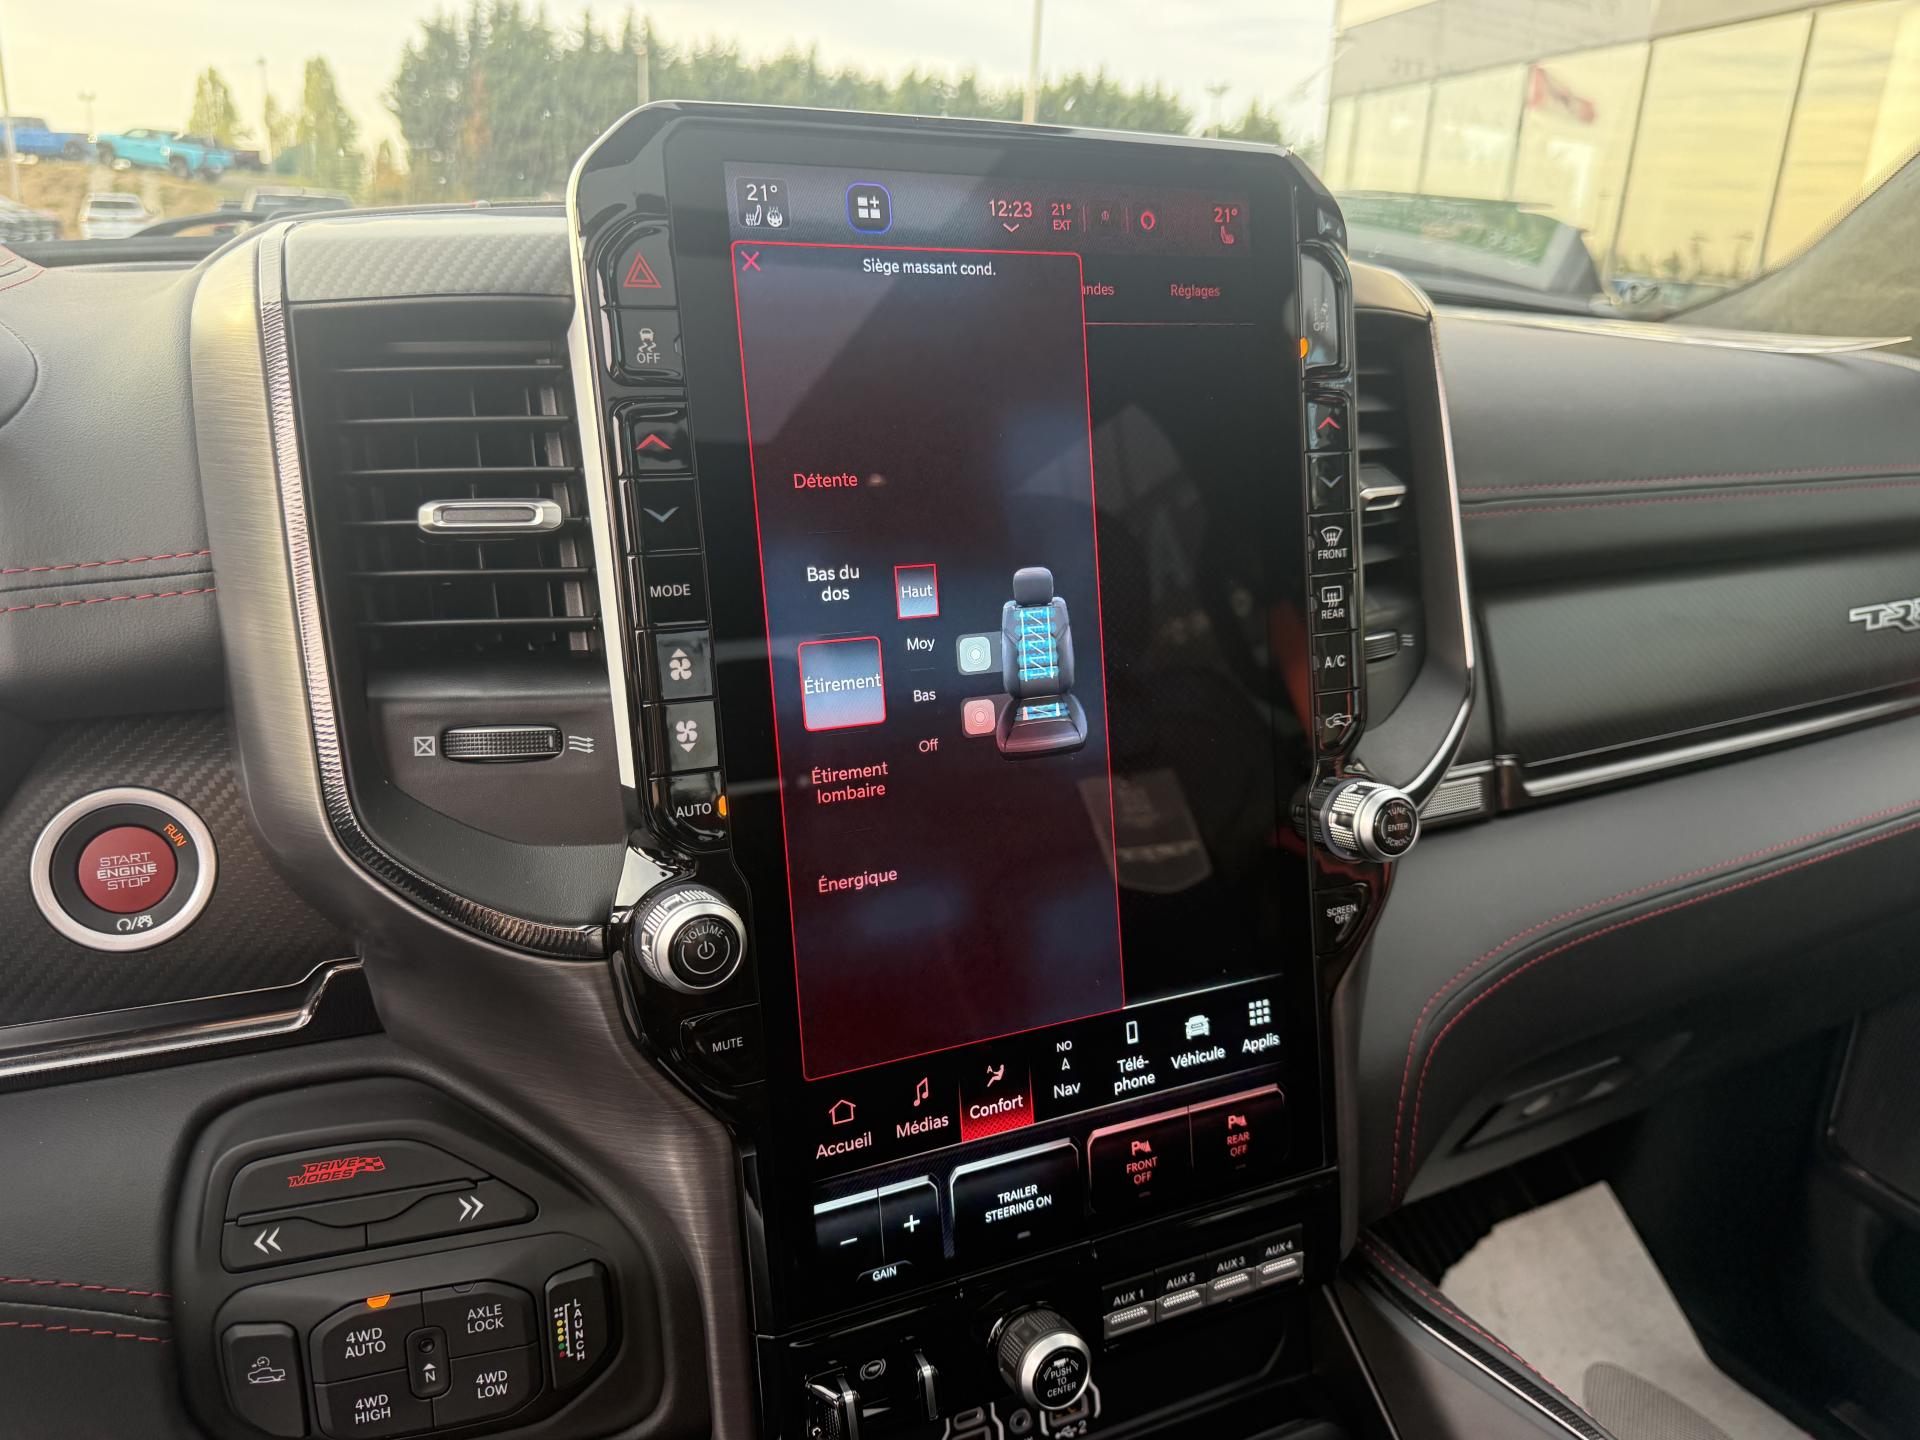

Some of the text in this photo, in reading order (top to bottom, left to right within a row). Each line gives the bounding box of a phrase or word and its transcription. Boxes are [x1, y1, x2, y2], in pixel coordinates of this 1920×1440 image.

[989, 199, 1033, 219] 12:23
[1053, 219, 1071, 231] EXT
[862, 257, 997, 276] Siège massant cond.
[1170, 284, 1221, 300] Réglages
[636, 352, 661, 364] OFF
[793, 472, 858, 490] Détente
[1317, 547, 1348, 560] FRONT
[806, 564, 860, 582] Bas du
[649, 583, 692, 598] MODE
[821, 586, 850, 602] dos
[901, 584, 933, 600] Haut
[1320, 607, 1345, 620] REAR
[1849, 597, 1920, 632] TR
[906, 636, 935, 652] Moy
[1324, 654, 1347, 669] A/C
[804, 672, 882, 694] Étirement
[913, 688, 937, 703] Bas
[918, 738, 940, 753] Off
[811, 761, 889, 785] Étirement
[816, 782, 887, 804] lombaire
[675, 801, 713, 819] AUTO
[1388, 806, 1408, 816] TUNE
[163, 822, 187, 847] RUN
[1387, 822, 1409, 832] ENTER
[1385, 836, 1411, 847] SCROLL
[100, 851, 152, 867] START
[96, 861, 158, 880] ENGINE
[107, 876, 151, 891] STOP
[817, 867, 898, 894] Énergique
[1326, 904, 1358, 917] SCREEN
[1334, 913, 1351, 925] OFF
[682, 924, 726, 946] VOLUME
[712, 1036, 744, 1053] MUTE
[1241, 1032, 1281, 1054] Applis
[1117, 1055, 1150, 1074] Télé-
[1170, 1045, 1227, 1070] Véhicule
[1053, 1081, 1081, 1099] Nav
[1114, 1071, 1156, 1095] phone
[969, 1093, 1024, 1120] Confort
[896, 1112, 950, 1139] Médias
[815, 1131, 873, 1160] Accueil
[1226, 1131, 1251, 1146] REAR
[1230, 1143, 1249, 1157] OFF
[304, 1158, 359, 1174] DRIVE
[1126, 1156, 1158, 1174] FRONT
[289, 1168, 354, 1187] MODES
[1133, 1171, 1153, 1185] OFF
[997, 1183, 1039, 1205] TRAILER
[984, 1194, 1053, 1224] STEERING ON
[1265, 1240, 1294, 1256] AUX 4
[1216, 1255, 1246, 1273] AUX 3
[871, 1266, 897, 1282] GAIN
[1165, 1271, 1196, 1290] AUX 2
[1113, 1288, 1145, 1306] AUX 1
[467, 1304, 502, 1319] AXLE
[467, 1317, 505, 1334] LOCK
[573, 1298, 586, 1361] LAUNCH
[346, 1327, 383, 1344] 4WD
[345, 1340, 387, 1359] AUTO
[425, 1370, 436, 1383] N
[475, 1370, 508, 1386] 4WD
[1050, 1366, 1072, 1379] PUSH
[1047, 1381, 1077, 1399] CENTER
[1057, 1377, 1067, 1387] TO
[477, 1383, 508, 1400] LOW
[355, 1393, 389, 1410] 4WD
[355, 1406, 391, 1425] HIGH
[1078, 1420, 1087, 1434] 2
